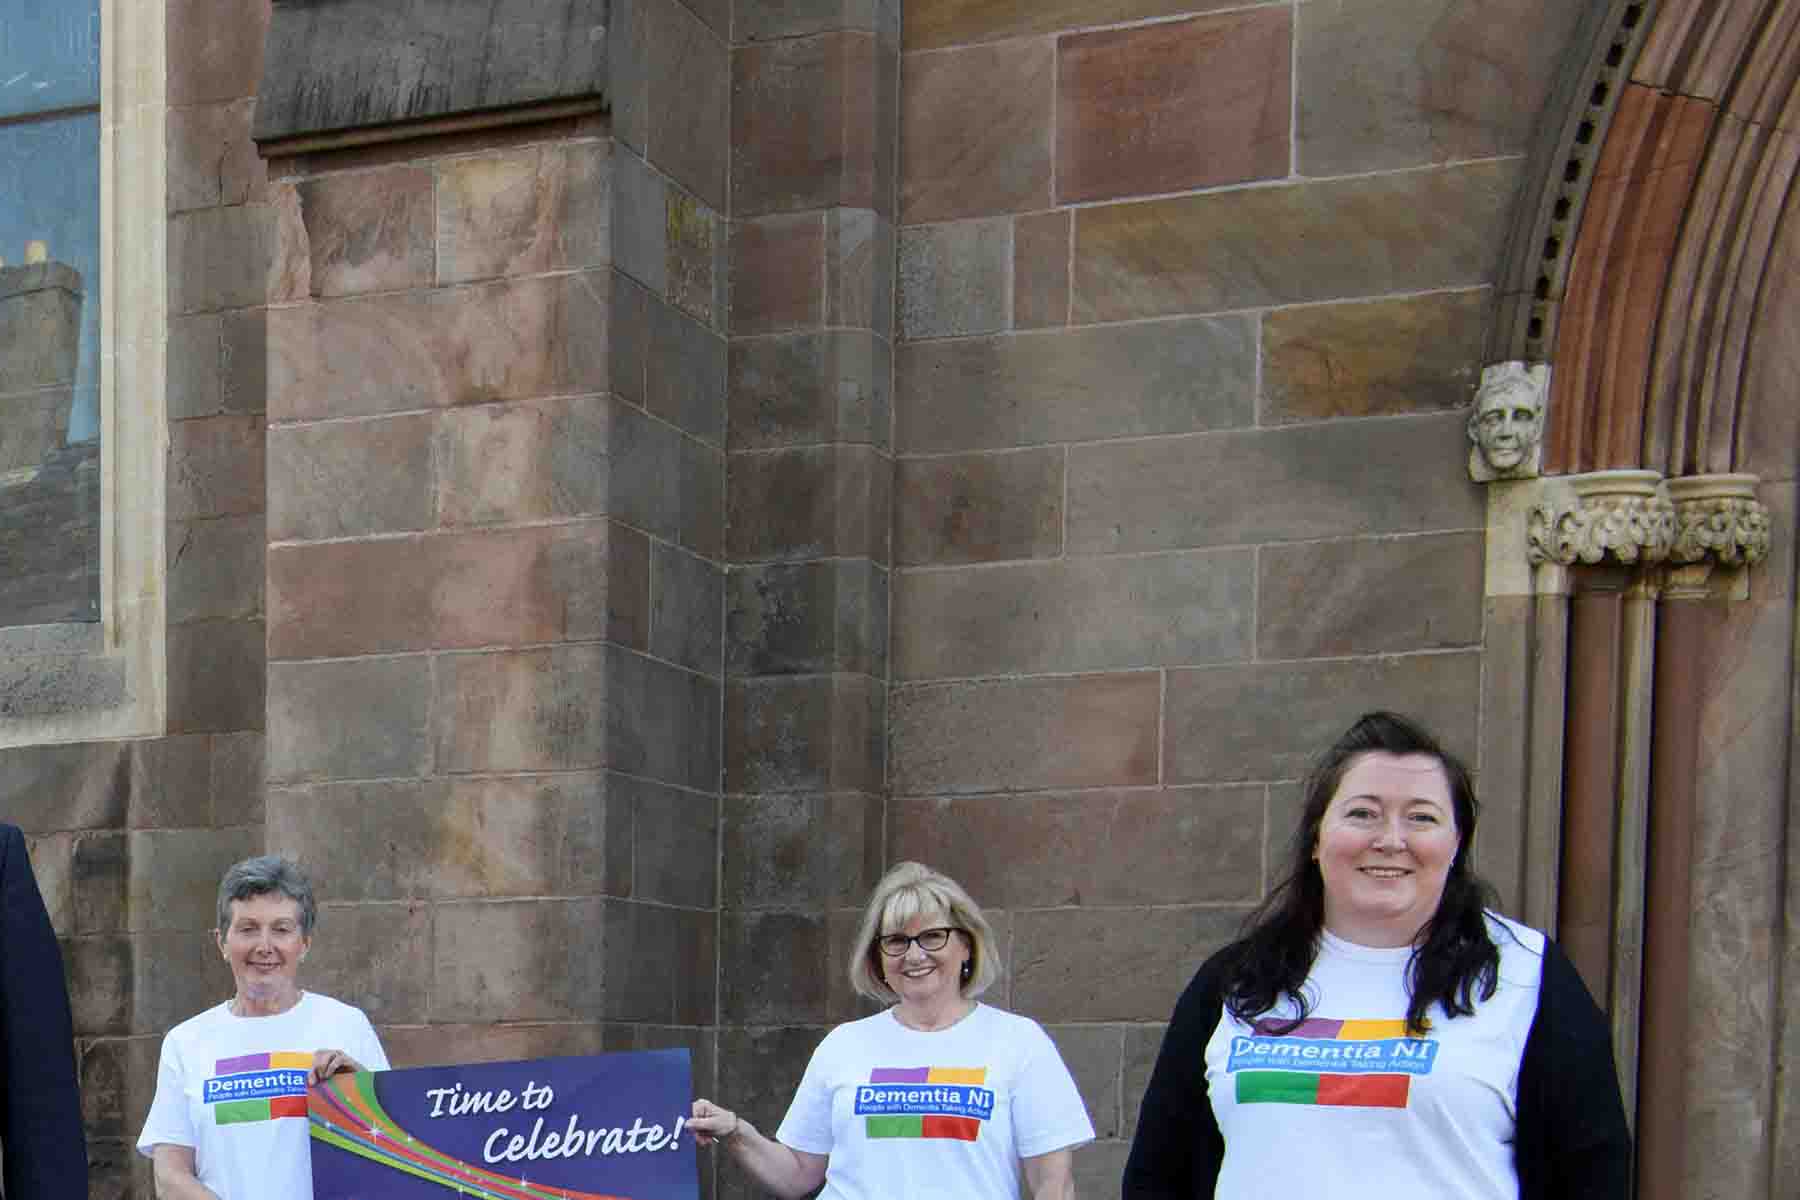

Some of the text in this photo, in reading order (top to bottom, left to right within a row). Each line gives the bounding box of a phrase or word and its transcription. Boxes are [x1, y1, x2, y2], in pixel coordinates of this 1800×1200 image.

[1235, 1039, 1432, 1059] Dementia NI
[208, 1072, 305, 1092] Dementia
[426, 1081, 553, 1117] Time to
[860, 1087, 990, 1107] Dementia NI
[484, 1115, 684, 1163] Celebrate!
